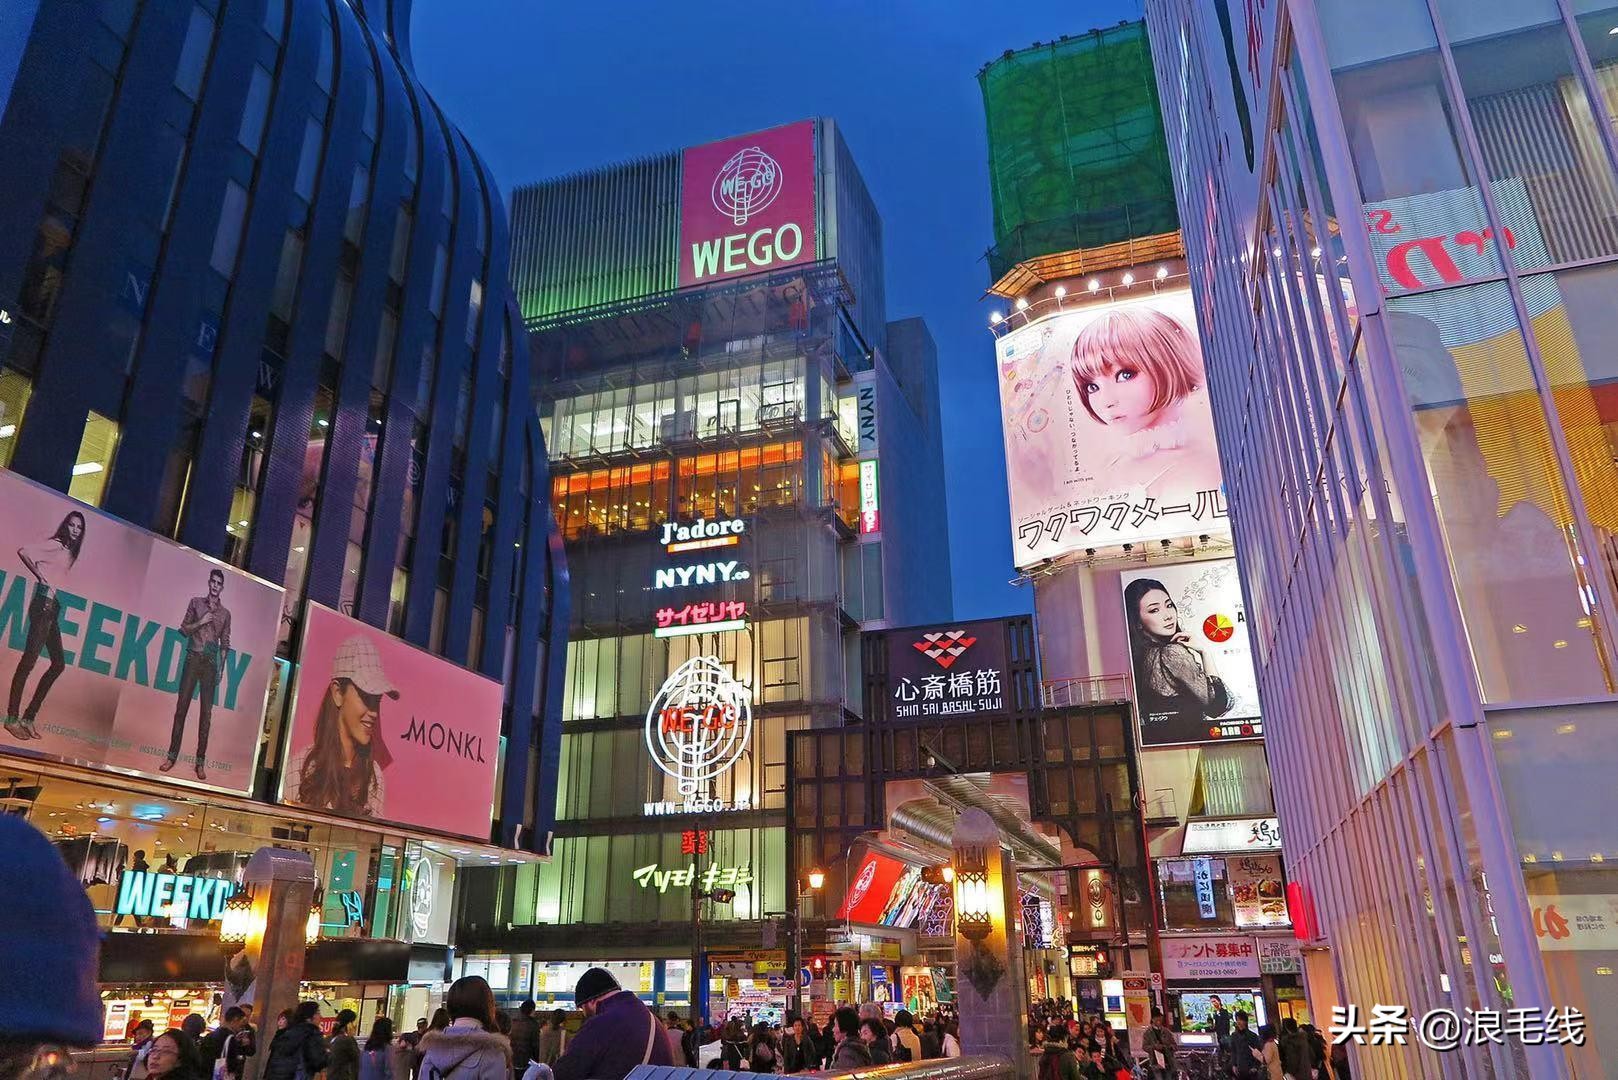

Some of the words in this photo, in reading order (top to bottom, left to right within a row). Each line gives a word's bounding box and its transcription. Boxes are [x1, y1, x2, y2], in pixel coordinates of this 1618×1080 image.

[692, 223, 803, 279] WEGO
[860, 387, 875, 442] NYNY
[660, 518, 744, 545] J'adore
[1018, 489, 1229, 550] ワクワクメール
[656, 600, 745, 628] サイゼリヤ
[894, 668, 1001, 702] 心斎橋筋
[896, 704, 919, 717] SHIN
[923, 702, 939, 716] SAI
[401, 715, 485, 763] MONKI
